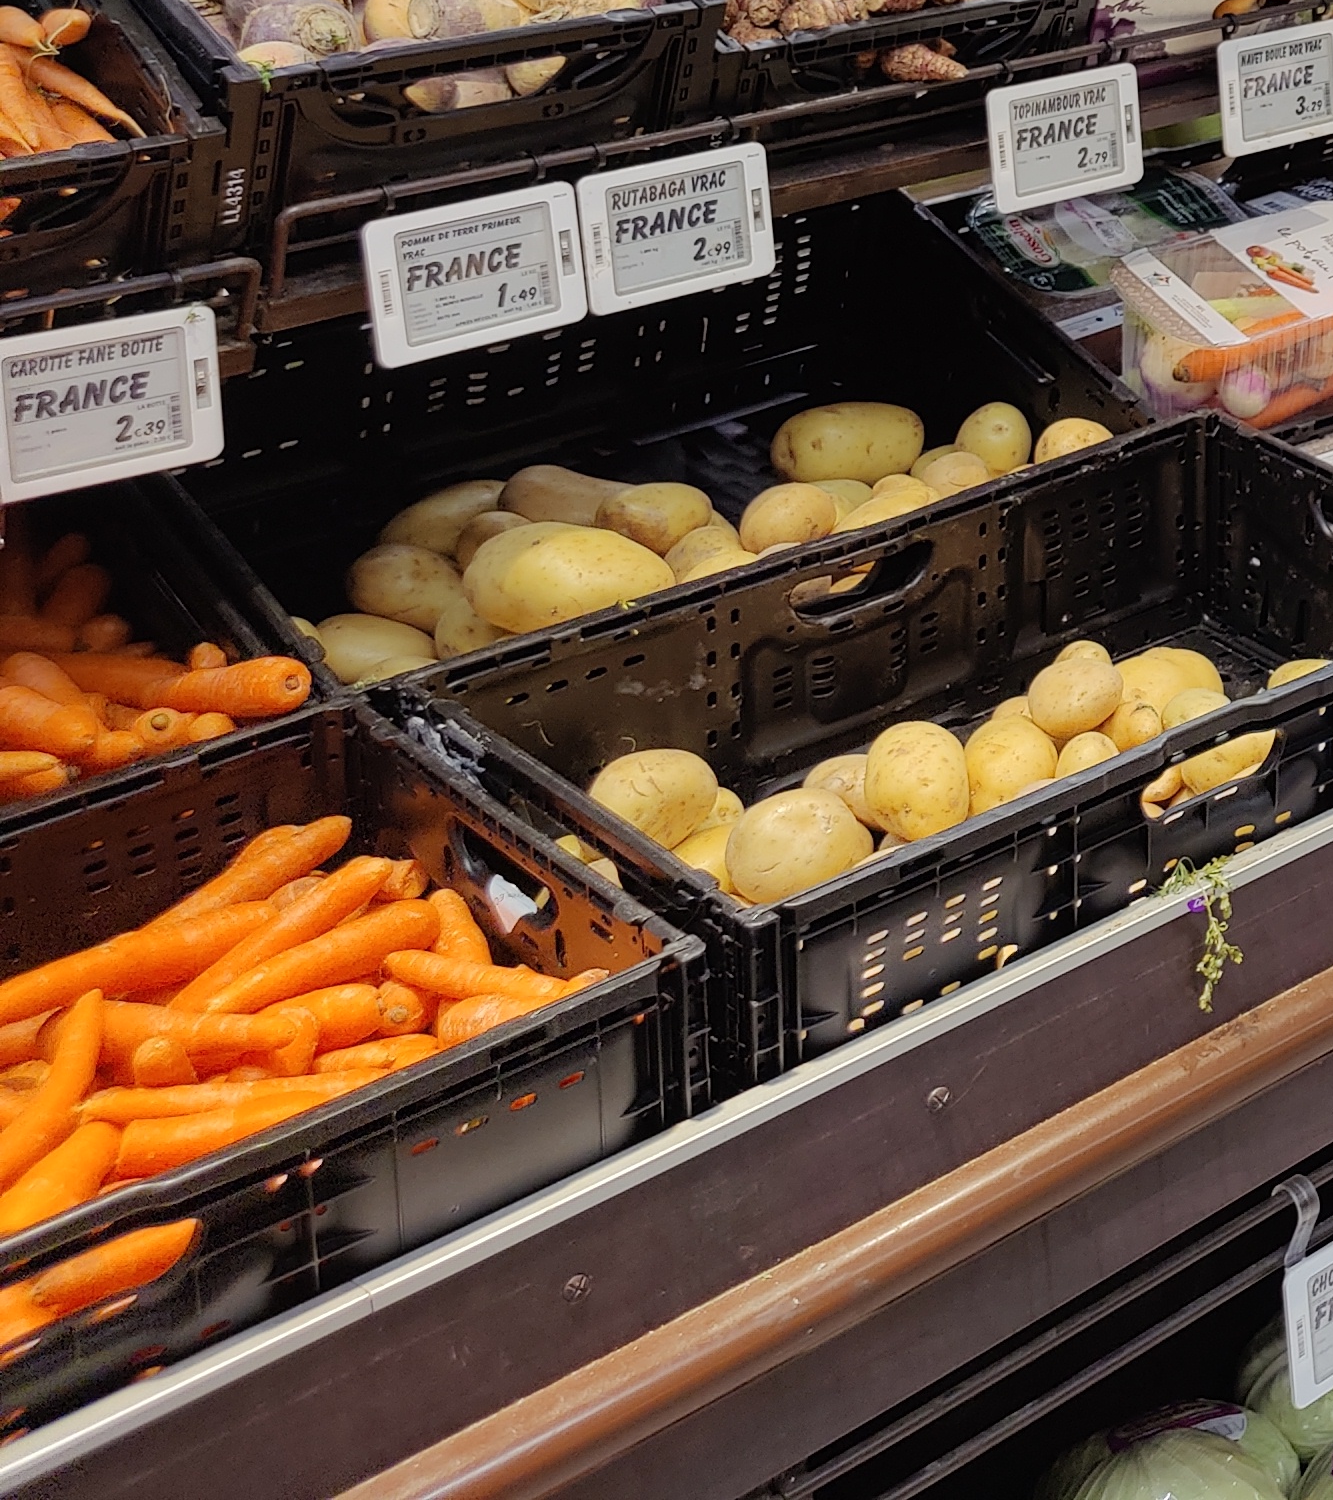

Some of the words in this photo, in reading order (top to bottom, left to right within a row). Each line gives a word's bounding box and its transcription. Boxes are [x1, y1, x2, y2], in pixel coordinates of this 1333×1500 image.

[1265, 45, 1287, 62] BOULE
[1243, 64, 1315, 99] FRANCE
[1013, 94, 1081, 121] TOPINAMBOUR
[1083, 87, 1106, 107] VRAC
[1016, 113, 1098, 151] FRANCE
[220, 168, 246, 225] LL4314
[611, 178, 686, 211] RUTABAGA
[691, 170, 727, 193] VRAC
[401, 233, 436, 249] POMME
[437, 230, 450, 241] DE
[452, 223, 480, 238] TERRE
[482, 216, 522, 232] PRIMEUR
[615, 199, 718, 244] FRANCE
[1277, 226, 1292, 238] le
[402, 248, 427, 261] VRAC
[1008, 218, 1054, 265] Gosselin
[406, 242, 522, 291] FRANCE
[10, 352, 73, 378] CAROTTE
[78, 343, 115, 366] FANE
[120, 336, 164, 358] BOTTE
[14, 371, 150, 422] FRANCE
